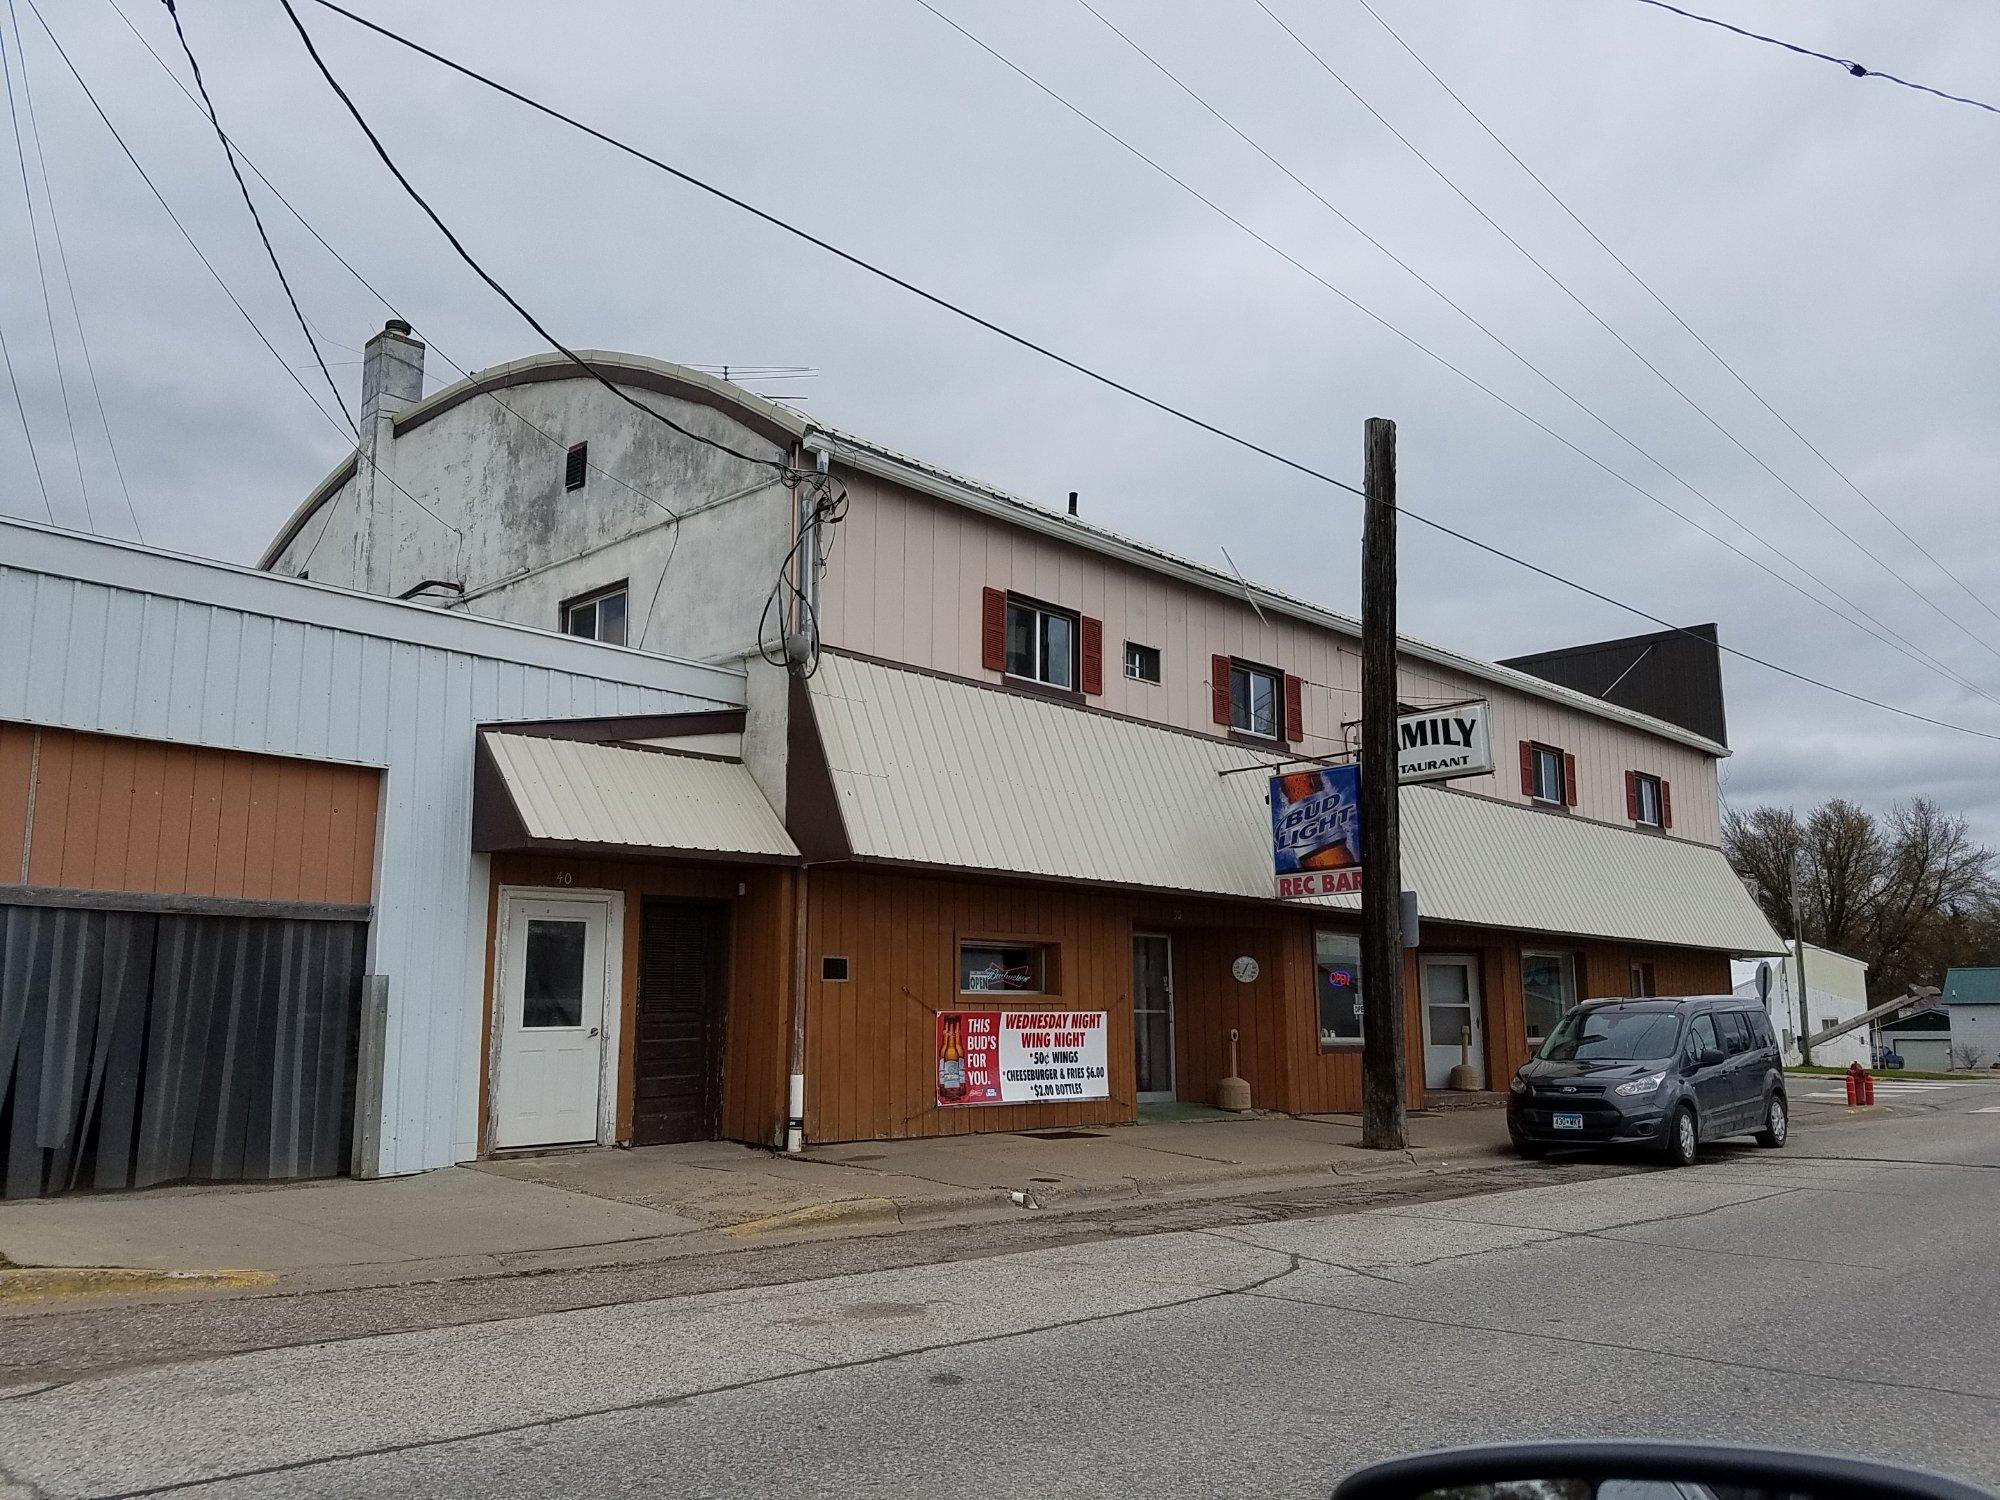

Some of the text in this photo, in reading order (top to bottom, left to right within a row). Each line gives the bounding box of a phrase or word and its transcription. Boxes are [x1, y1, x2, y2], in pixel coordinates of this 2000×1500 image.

[1397, 718, 1476, 751] MILY
[1399, 755, 1469, 774] TAURANT
[1285, 794, 1341, 829] BUD
[1278, 804, 1355, 850] LIGHT
[556, 871, 572, 884] 40
[1280, 875, 1315, 896] REC
[970, 976, 988, 990] OPEN
[1330, 972, 1349, 985] OPEN
[968, 1019, 990, 1033] THIS
[1006, 1014, 1101, 1029] WEDNESDAY NIGHT
[968, 1036, 996, 1050] BUD'S
[1021, 1032, 1085, 1048] WING NIGHT
[968, 1054, 986, 1068] FOR
[1052, 1051, 1078, 1063] WINGS
[968, 1071, 991, 1086] YOU.
[1060, 1068, 1065, 1079] &
[1067, 1067, 1084, 1079] FRIES
[1086, 1066, 1104, 1080] $6.00
[1055, 1083, 1083, 1095] BOTTLES
